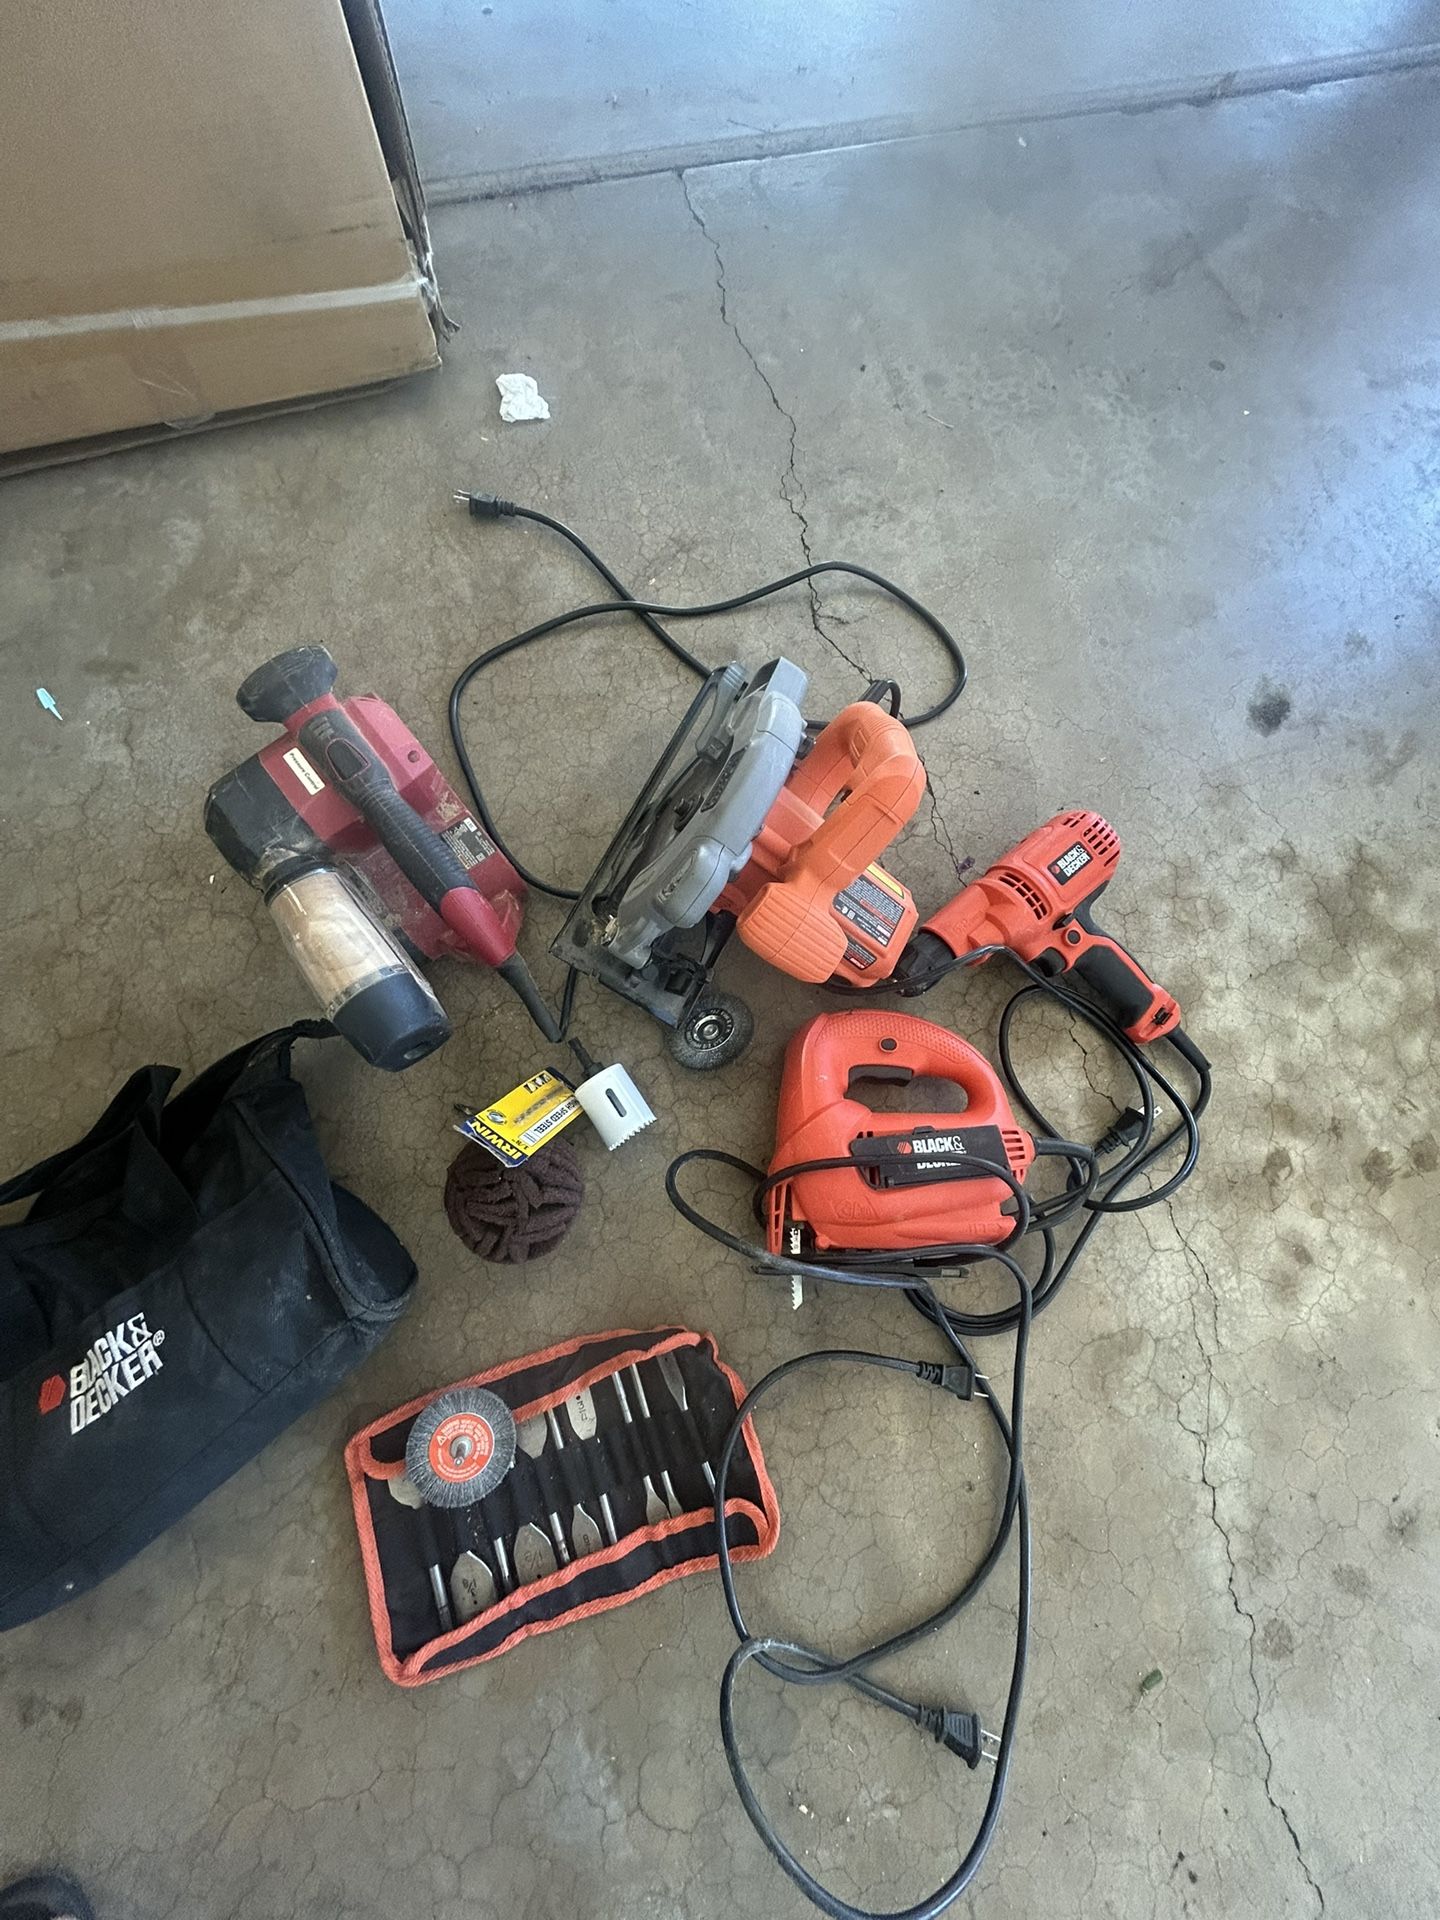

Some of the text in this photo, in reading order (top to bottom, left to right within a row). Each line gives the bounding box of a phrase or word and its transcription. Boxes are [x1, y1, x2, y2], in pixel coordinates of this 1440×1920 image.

[1062, 852, 1090, 877] DECKER
[534, 1119, 553, 1134] STEEL
[550, 1107, 568, 1122] SPEED
[472, 1120, 523, 1160] IRWIN
[70, 1339, 164, 1436] DECKER
